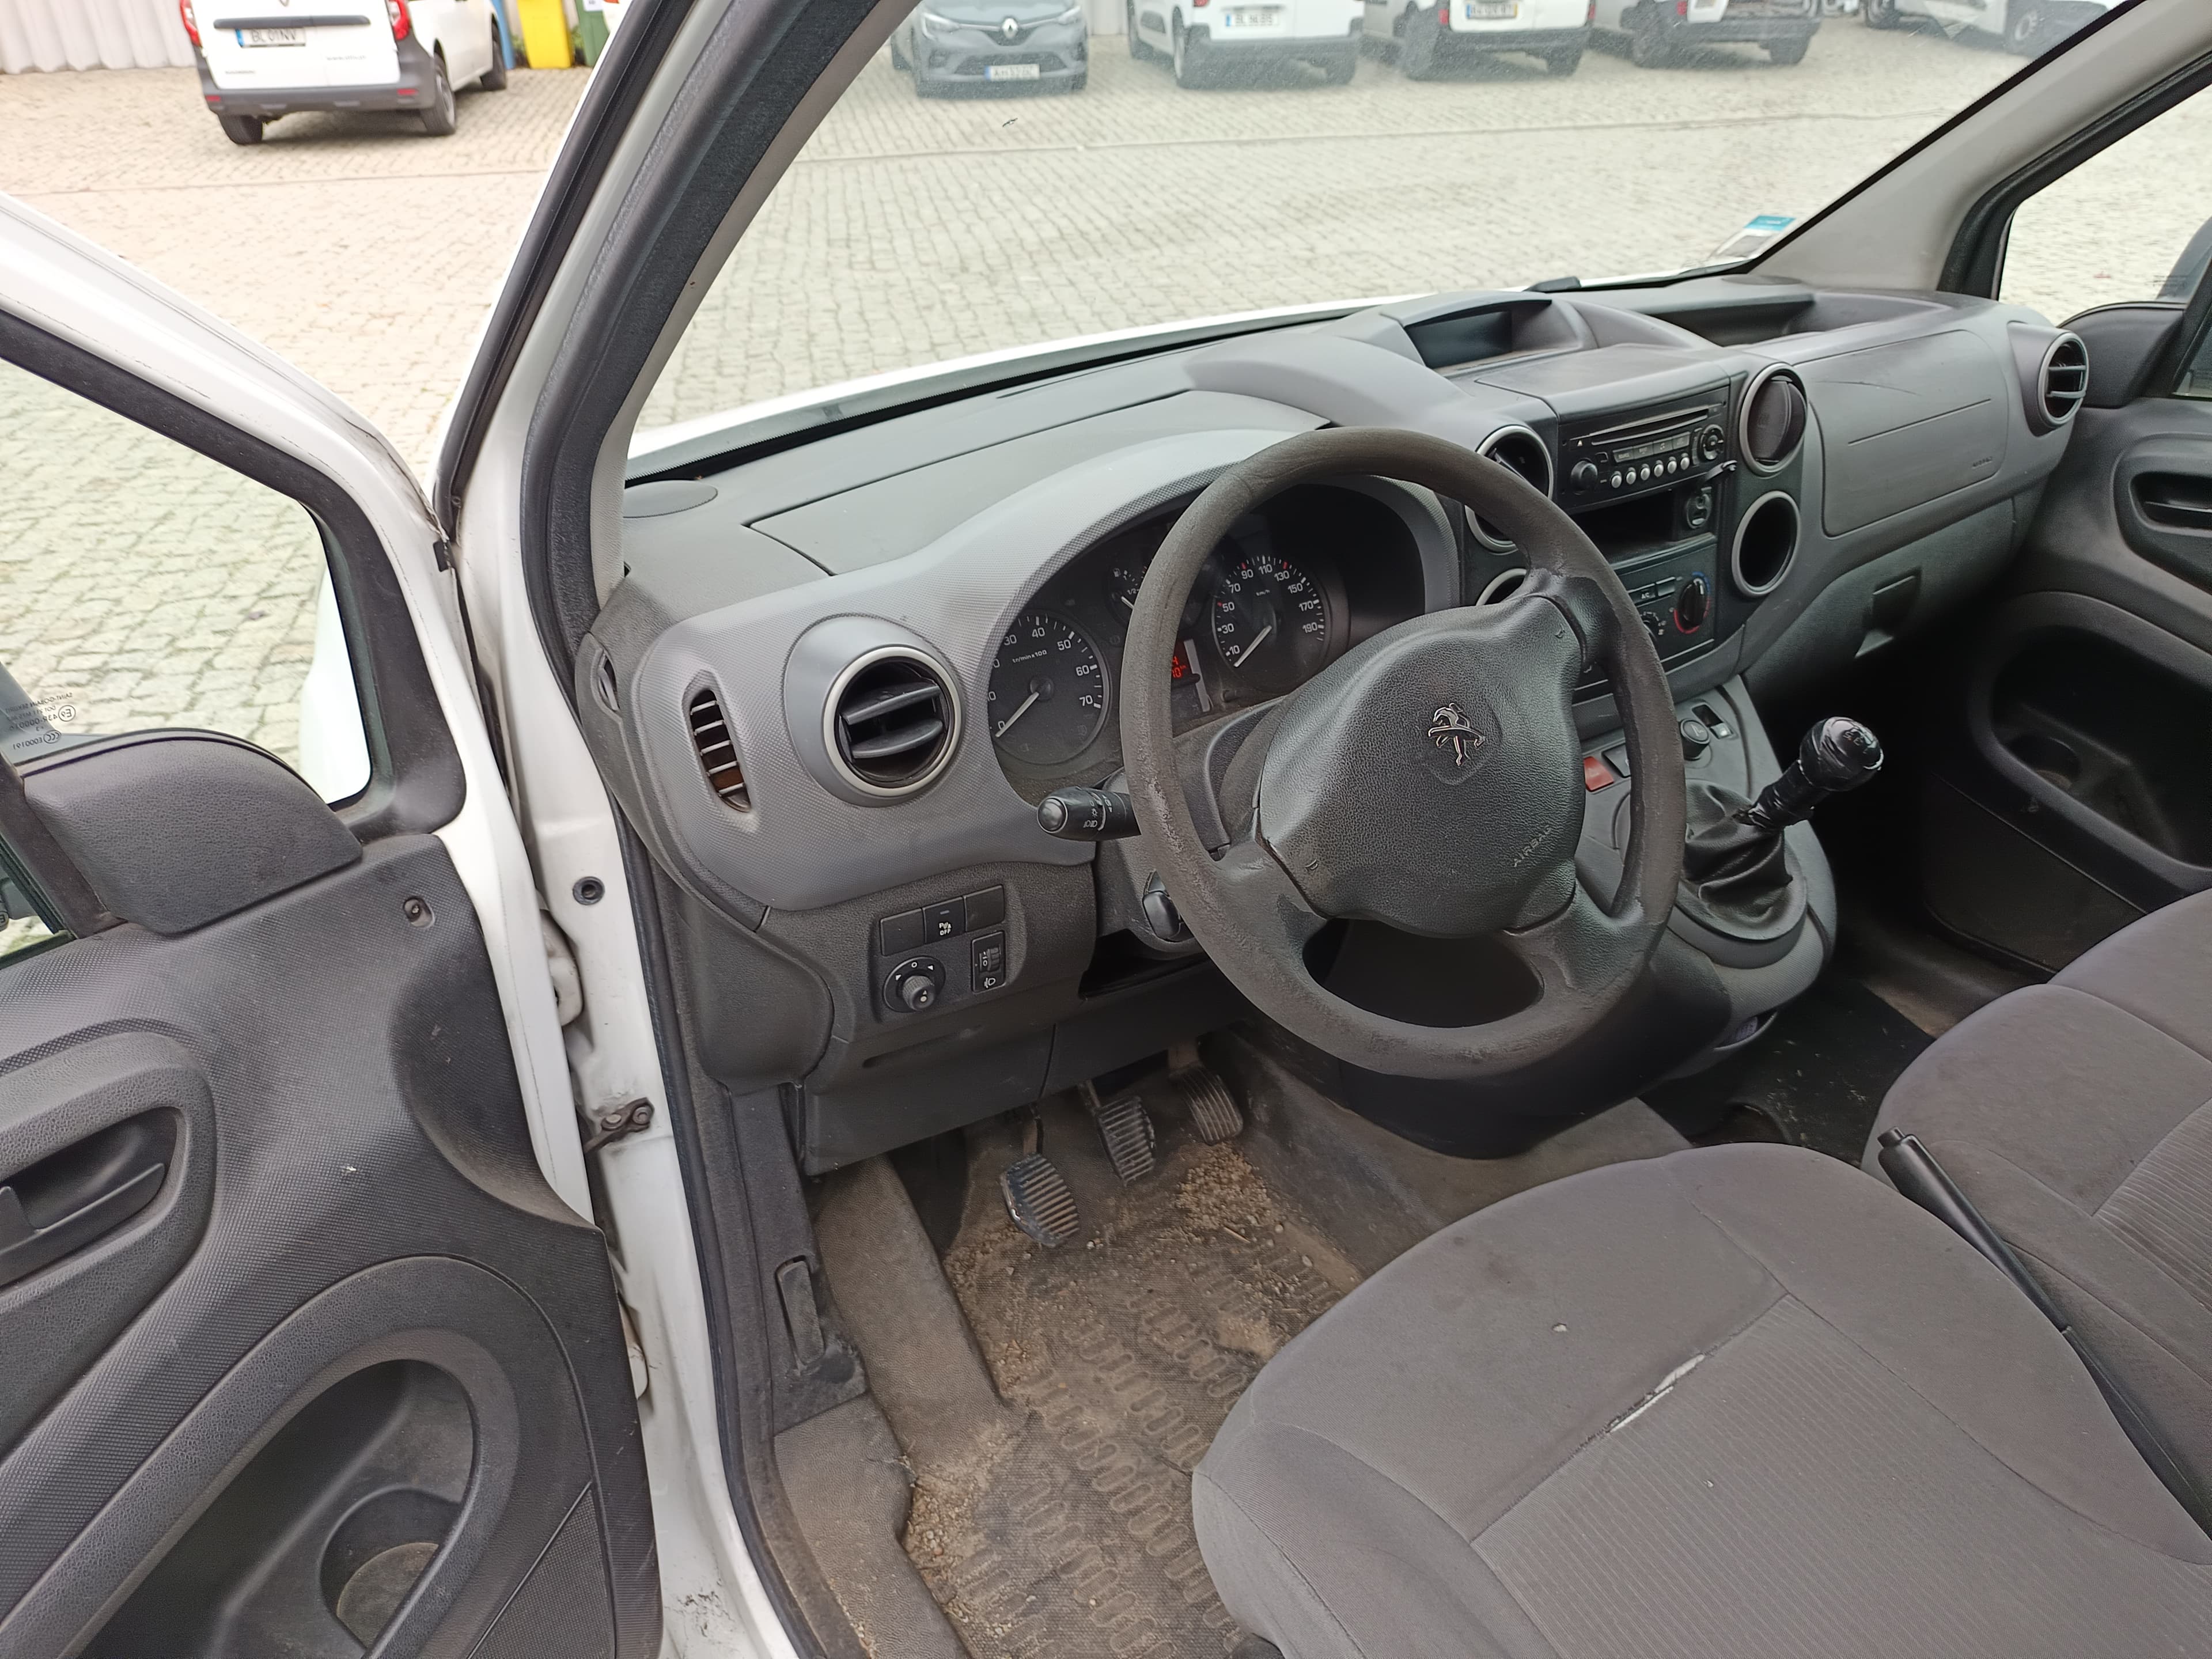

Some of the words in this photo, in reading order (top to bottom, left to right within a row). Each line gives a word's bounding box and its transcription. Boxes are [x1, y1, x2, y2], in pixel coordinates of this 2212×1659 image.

[1241, 569, 1253, 579] 90
[1259, 564, 1272, 575] 110
[1274, 570, 1290, 582] 130
[1228, 583, 1241, 594] 70
[1287, 582, 1303, 594] 150
[1222, 602, 1235, 612] 50
[1298, 600, 1314, 612] 170
[1032, 627, 1046, 638] 40
[1221, 623, 1234, 634] 30
[1302, 622, 1317, 633] 190
[1003, 634, 1017, 646] 30
[1056, 639, 1071, 651] 50
[1229, 645, 1240, 655] 10
[1075, 664, 1090, 676] 60
[1079, 695, 1093, 706] 70
[998, 721, 1006, 730] 0
[1514, 824, 1552, 868] AIRBAG
